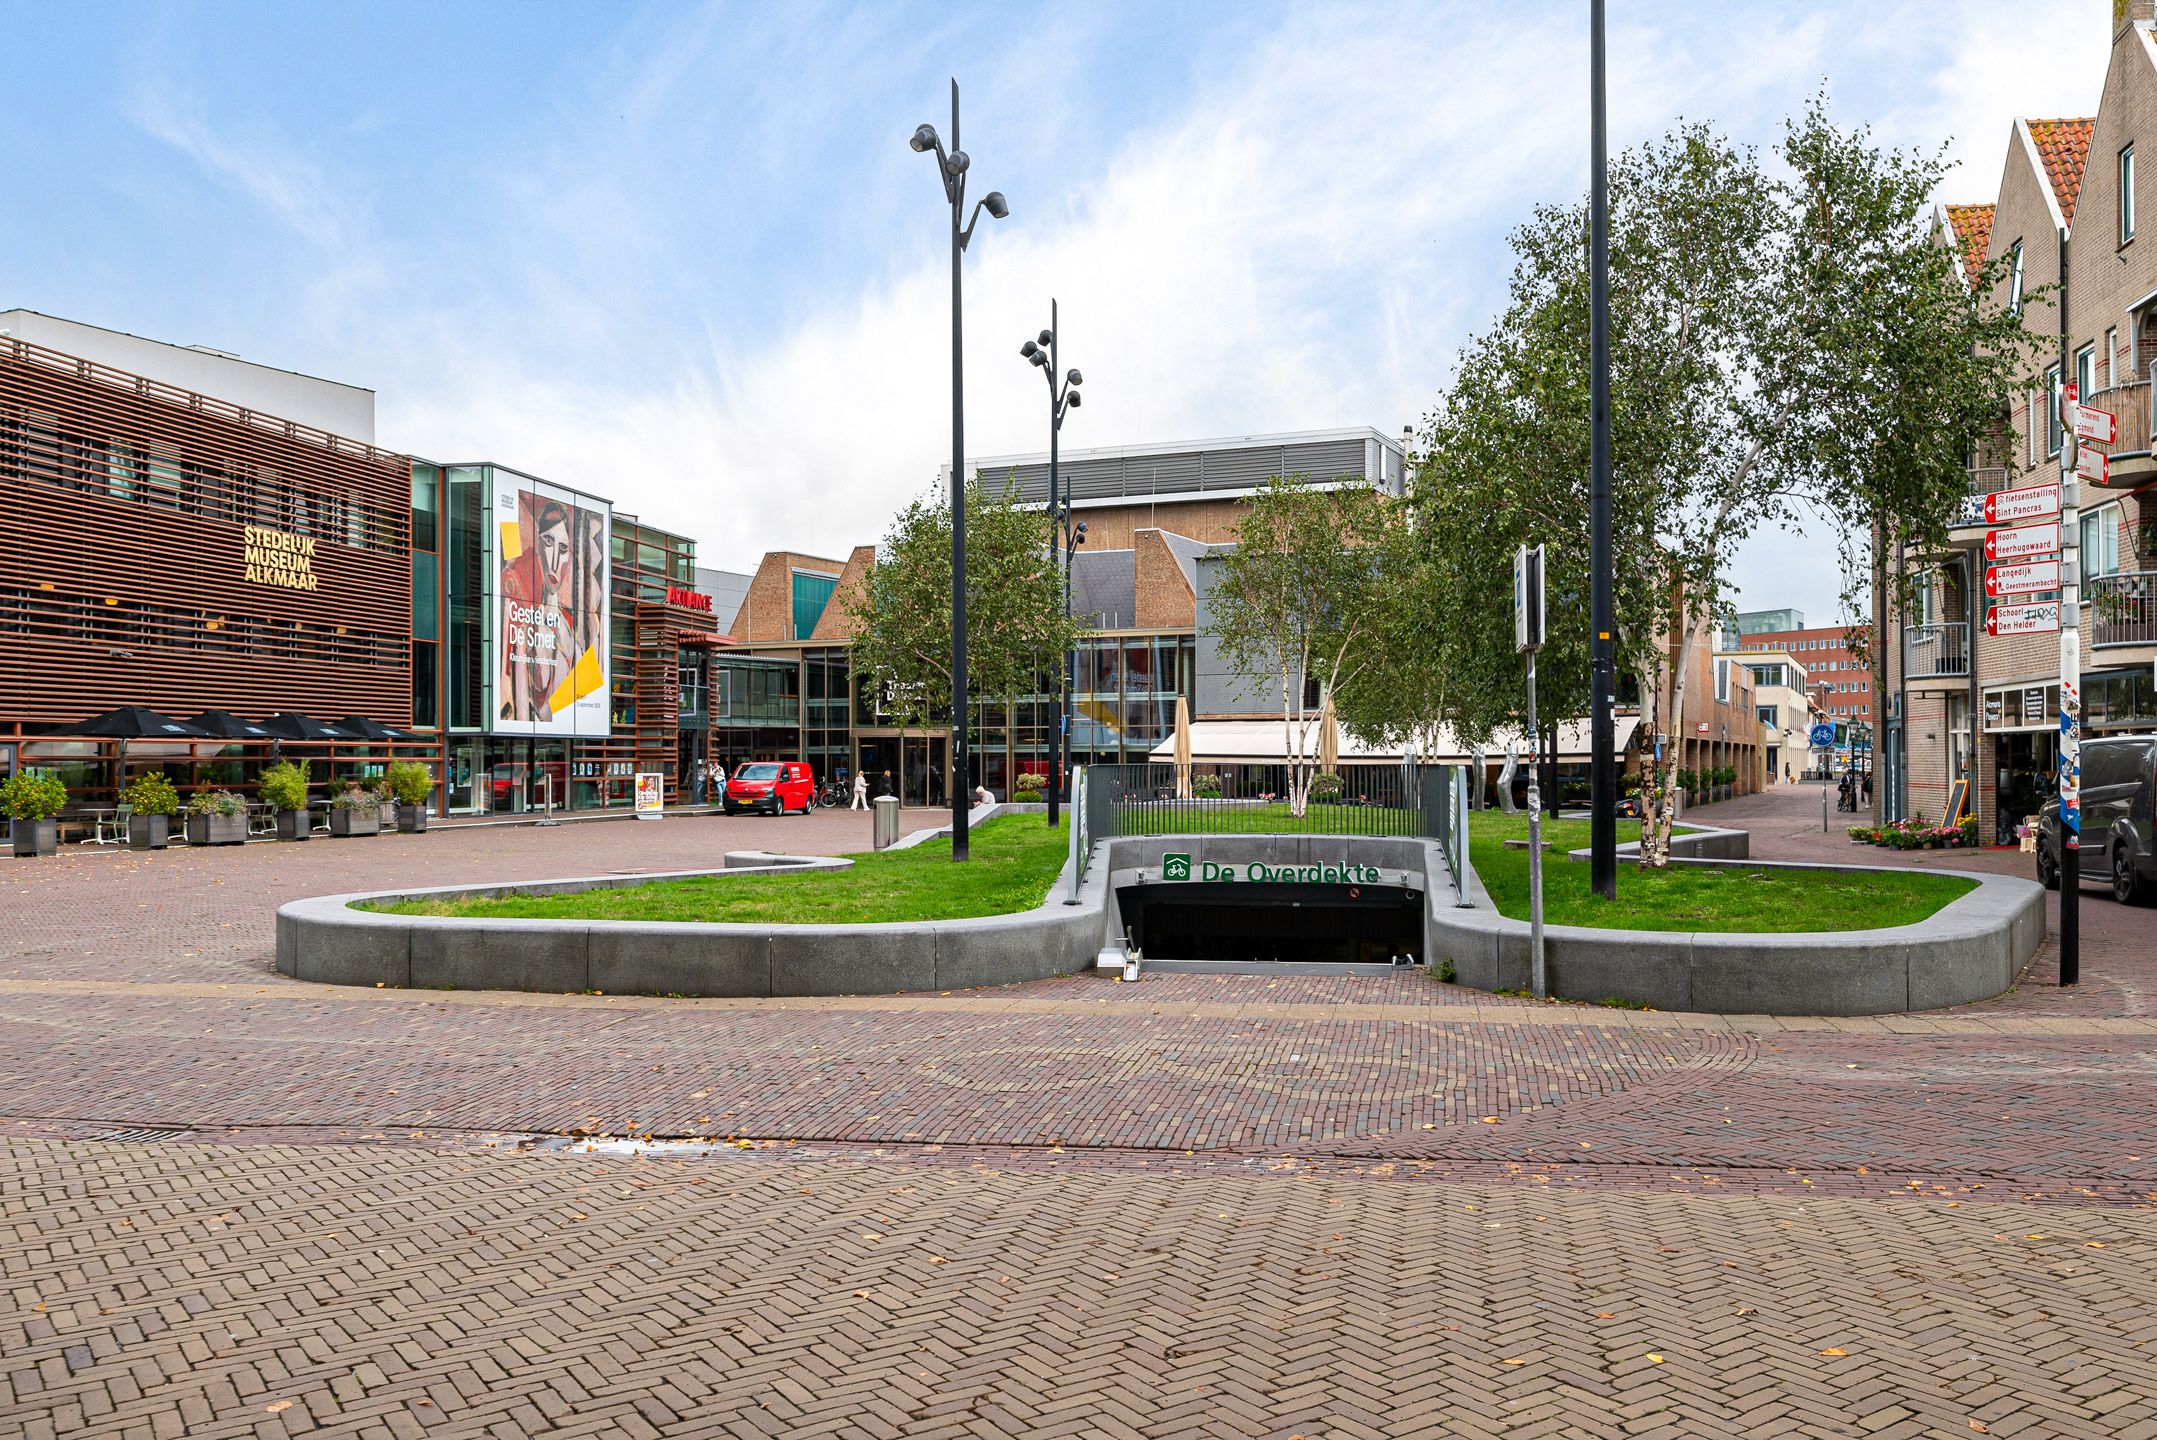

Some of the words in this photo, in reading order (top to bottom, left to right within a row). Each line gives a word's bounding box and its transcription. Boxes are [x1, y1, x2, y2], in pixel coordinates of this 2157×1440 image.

[2005, 488, 2057, 503] fietsenstalling
[1996, 507, 2011, 517] Sint
[2013, 504, 2042, 515] Pancras
[244, 525, 316, 556] STEDELIJK
[1997, 532, 2018, 541] Hoorn
[1997, 540, 2051, 554] Heerhugowaard
[244, 544, 311, 573] MUSEUM
[244, 563, 318, 591] ALKMAAR
[1997, 567, 2032, 578] Langedijk
[2005, 579, 2057, 590] Geestmerambacht
[509, 601, 545, 626] Gestel
[546, 611, 561, 628] en
[1998, 607, 2024, 618] Schoorl
[1998, 622, 2012, 631] Den
[2013, 620, 2037, 630] Helder
[509, 624, 526, 646] De
[527, 626, 556, 650] Smet
[1201, 861, 1235, 882] De
[1247, 860, 1382, 884] Overdekte
